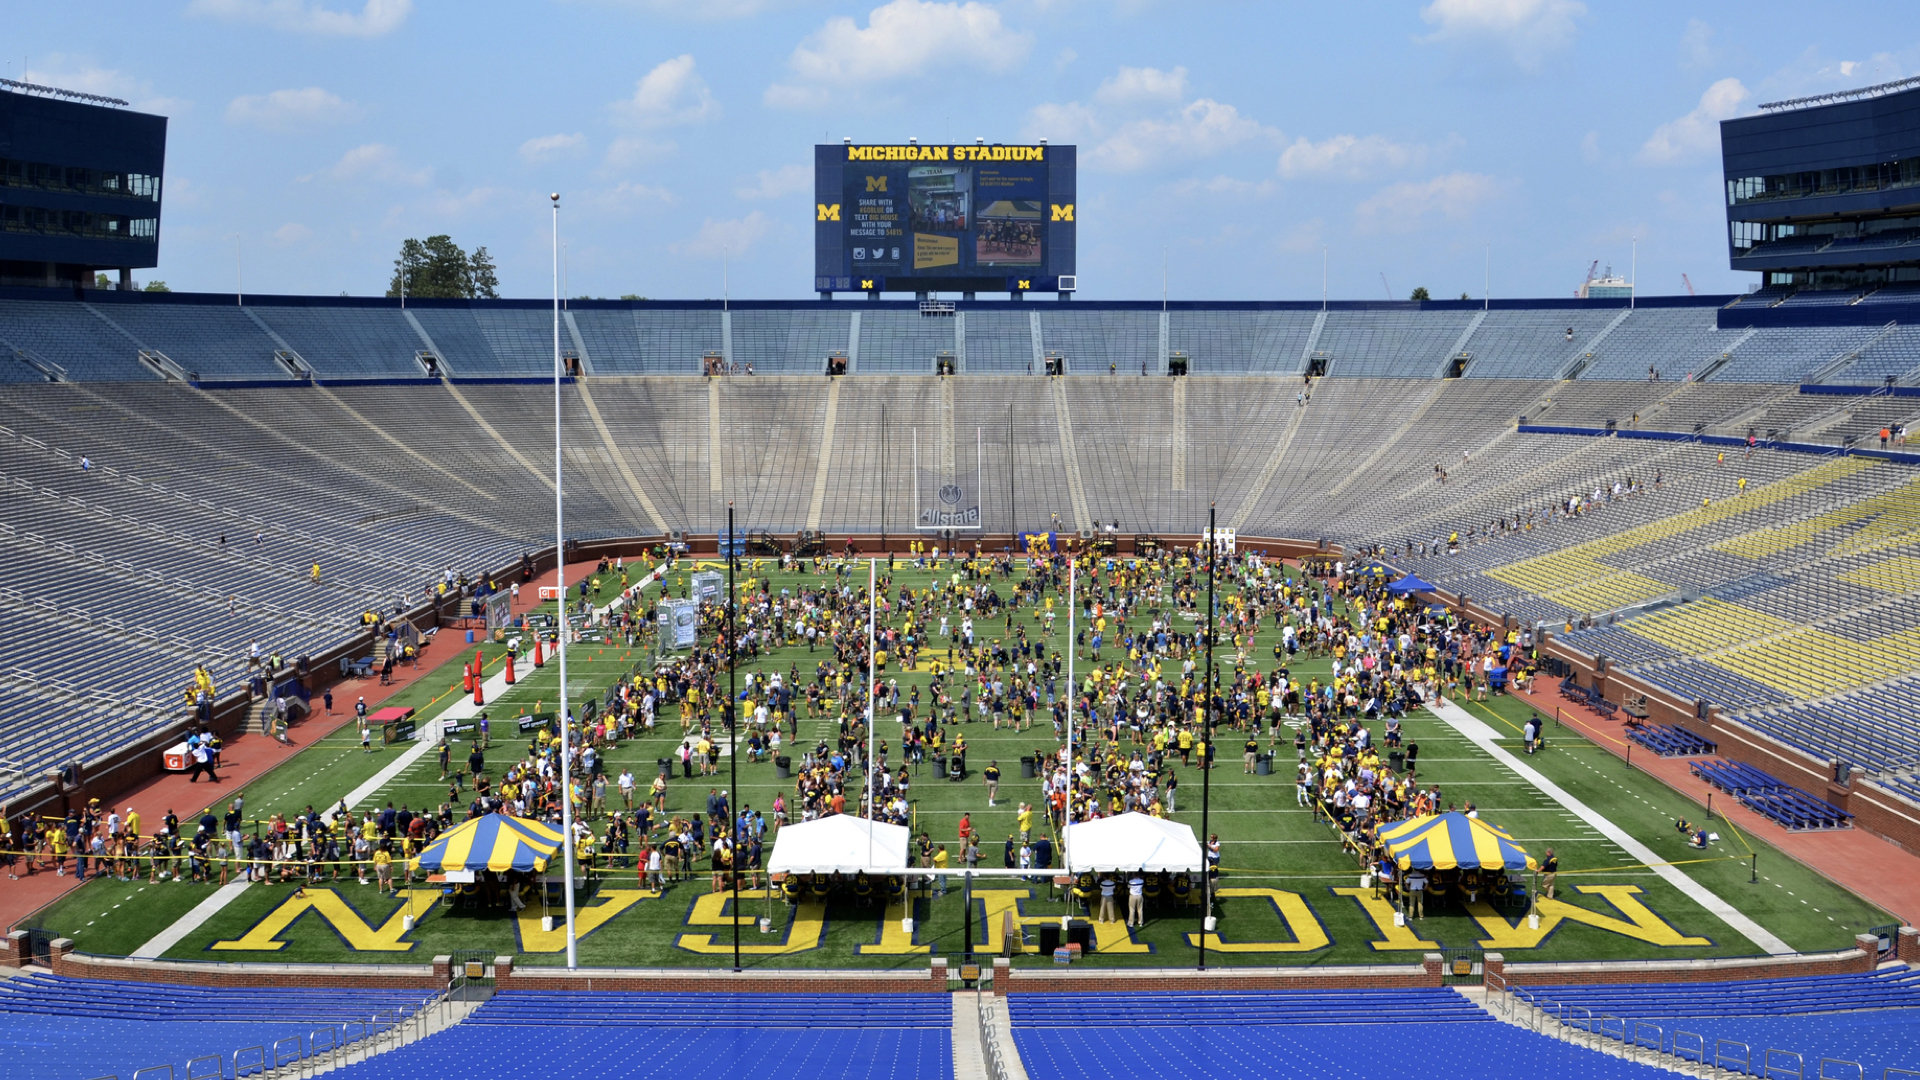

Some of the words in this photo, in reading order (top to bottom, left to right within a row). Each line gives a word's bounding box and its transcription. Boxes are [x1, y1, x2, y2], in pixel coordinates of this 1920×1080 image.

[848, 146, 948, 160] MICHIGAN
[954, 146, 1044, 160] STADIUM
[866, 176, 887, 192] M
[818, 204, 840, 221] M
[1051, 204, 1074, 221] M
[862, 280, 873, 289] M
[1018, 280, 1030, 289] M
[921, 508, 978, 526] Allstate
[169, 757, 178, 767] G
[815, 875, 825, 884] 19
[1080, 877, 1091, 886] 59
[1467, 875, 1477, 884] 94
